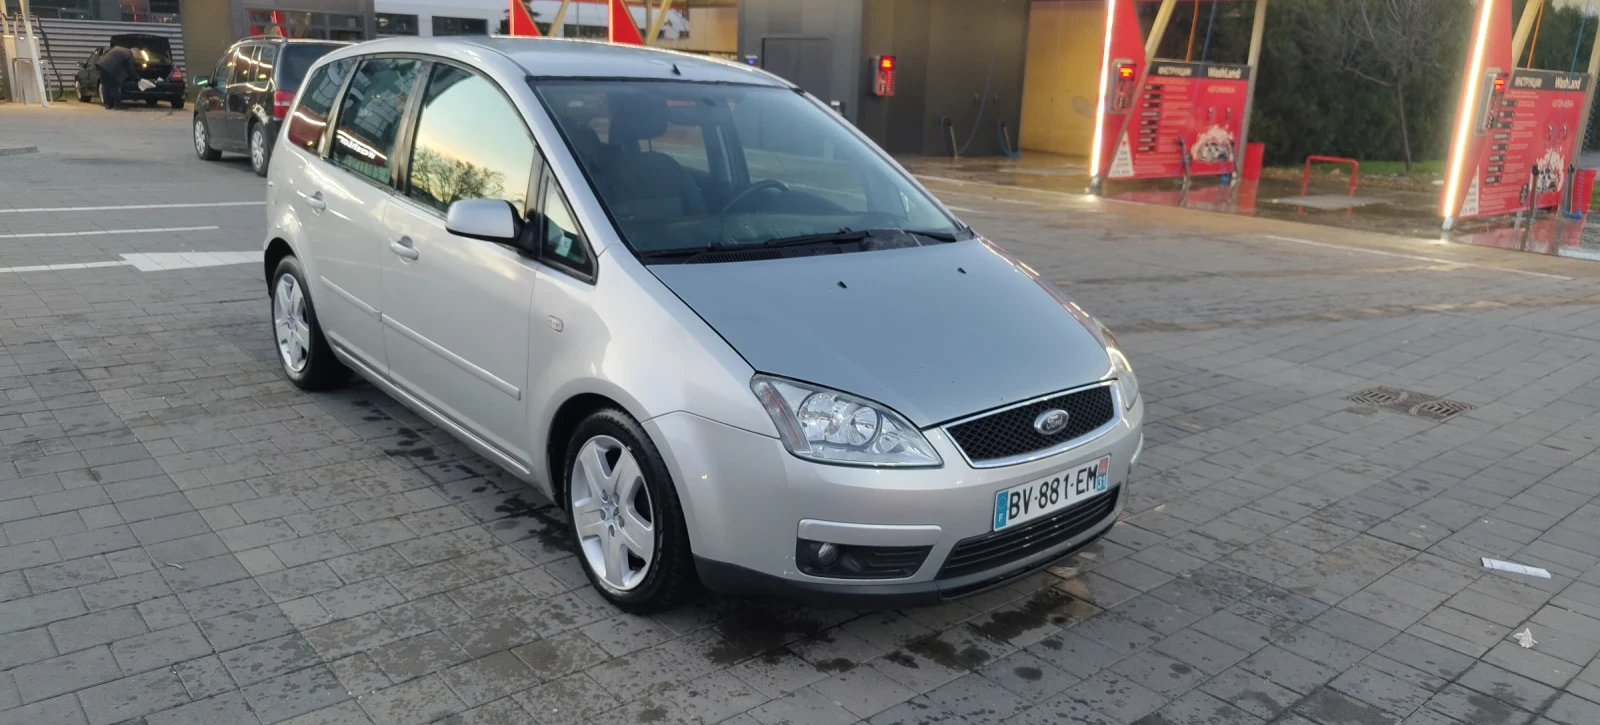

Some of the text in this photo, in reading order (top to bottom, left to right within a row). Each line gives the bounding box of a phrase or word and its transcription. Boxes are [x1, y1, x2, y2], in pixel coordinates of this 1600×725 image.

[1207, 66, 1242, 79] WashLand
[1046, 414, 1063, 430] Ford
[1008, 464, 1098, 520] BV-881-EM
[1098, 475, 1105, 488] 31
